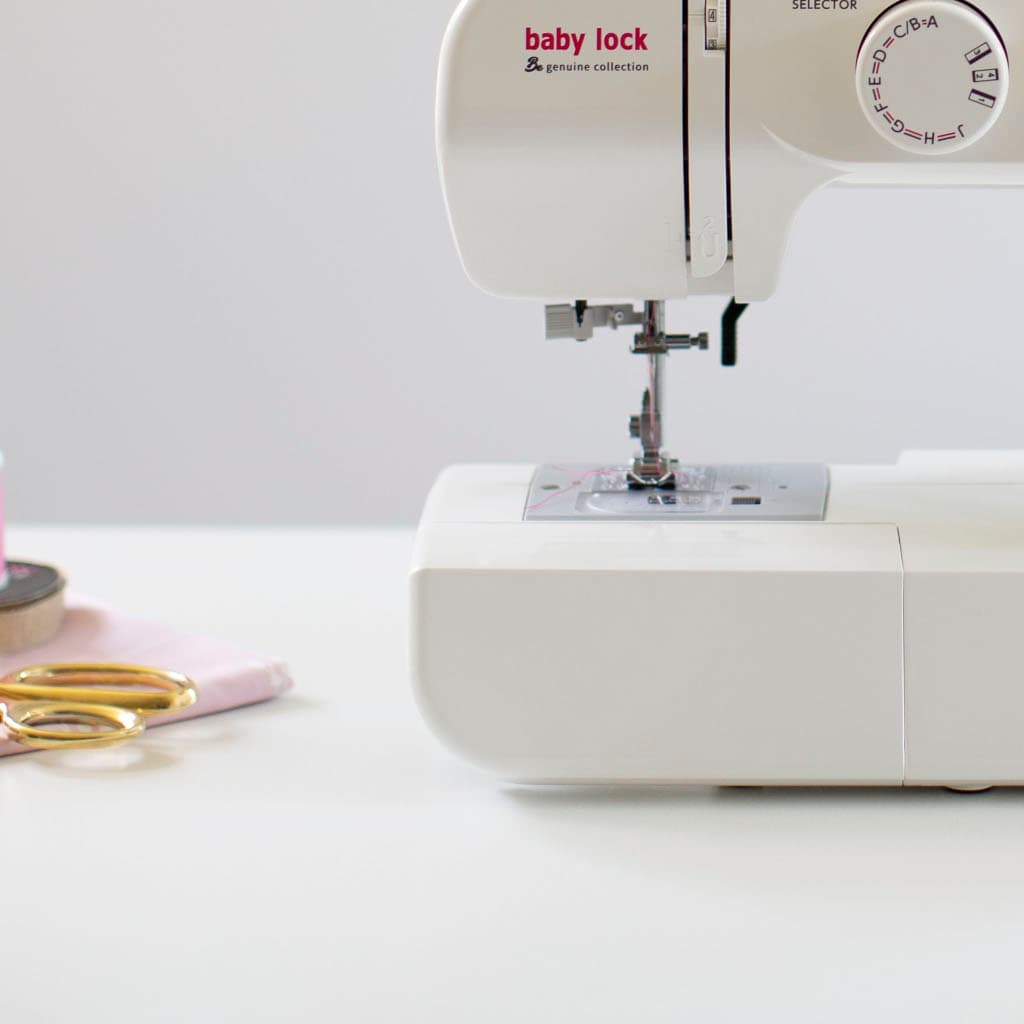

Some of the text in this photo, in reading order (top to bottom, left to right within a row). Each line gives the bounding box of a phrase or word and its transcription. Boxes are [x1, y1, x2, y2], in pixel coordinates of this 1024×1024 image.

[525, 27, 648, 56] baby lock
[872, 49, 888, 63] D
[524, 56, 649, 73] Be genuine collection
[868, 76, 881, 86] E
[874, 103, 888, 113] F
[891, 119, 905, 133] G
[924, 131, 935, 144] H
